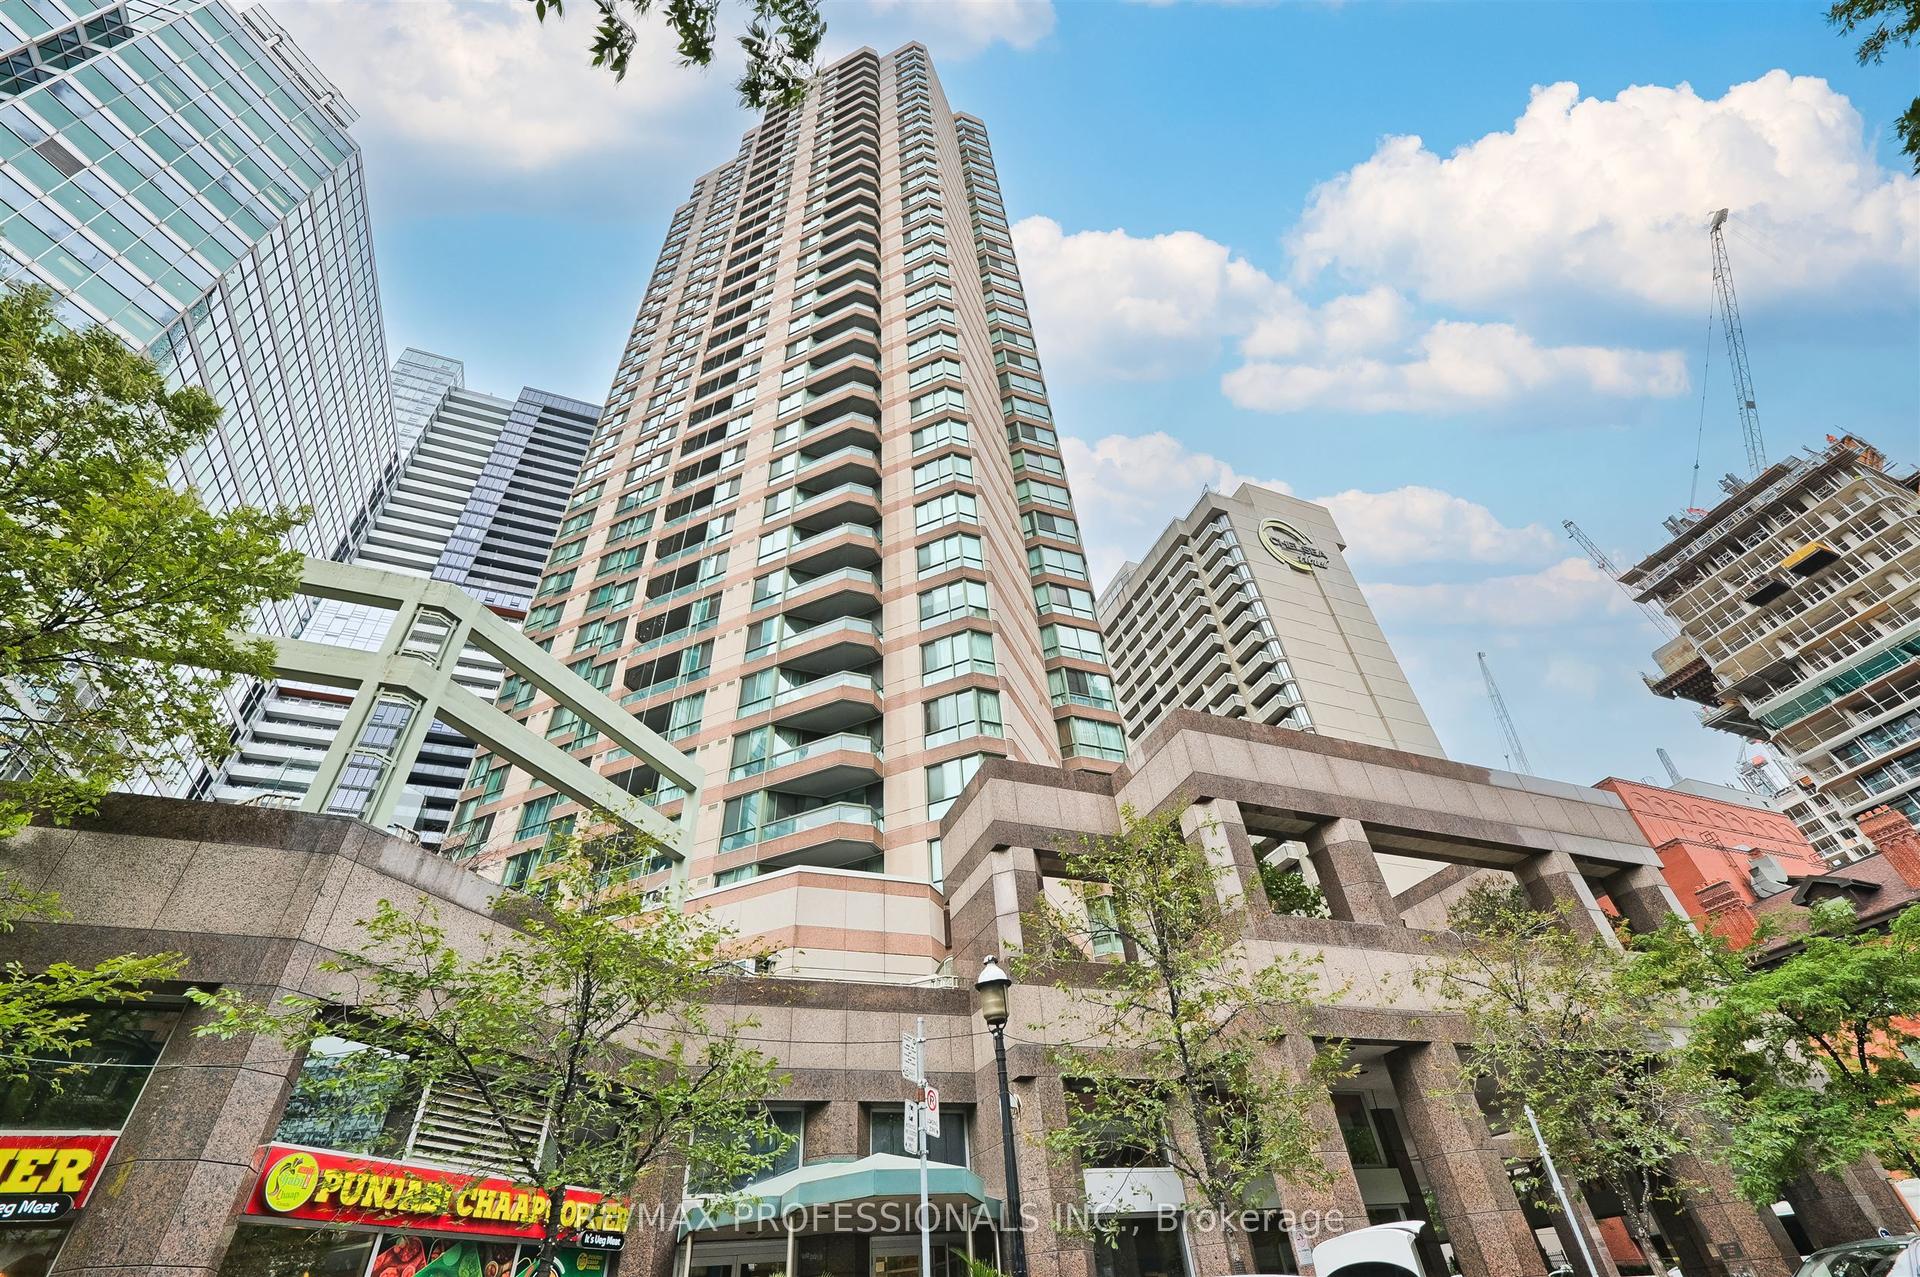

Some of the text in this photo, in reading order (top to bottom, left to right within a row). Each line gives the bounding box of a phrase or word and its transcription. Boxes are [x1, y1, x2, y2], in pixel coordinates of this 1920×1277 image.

[17, 1199, 60, 1214] Meat
[456, 1188, 547, 1223] CHAAP
[584, 1233, 595, 1244] It's
